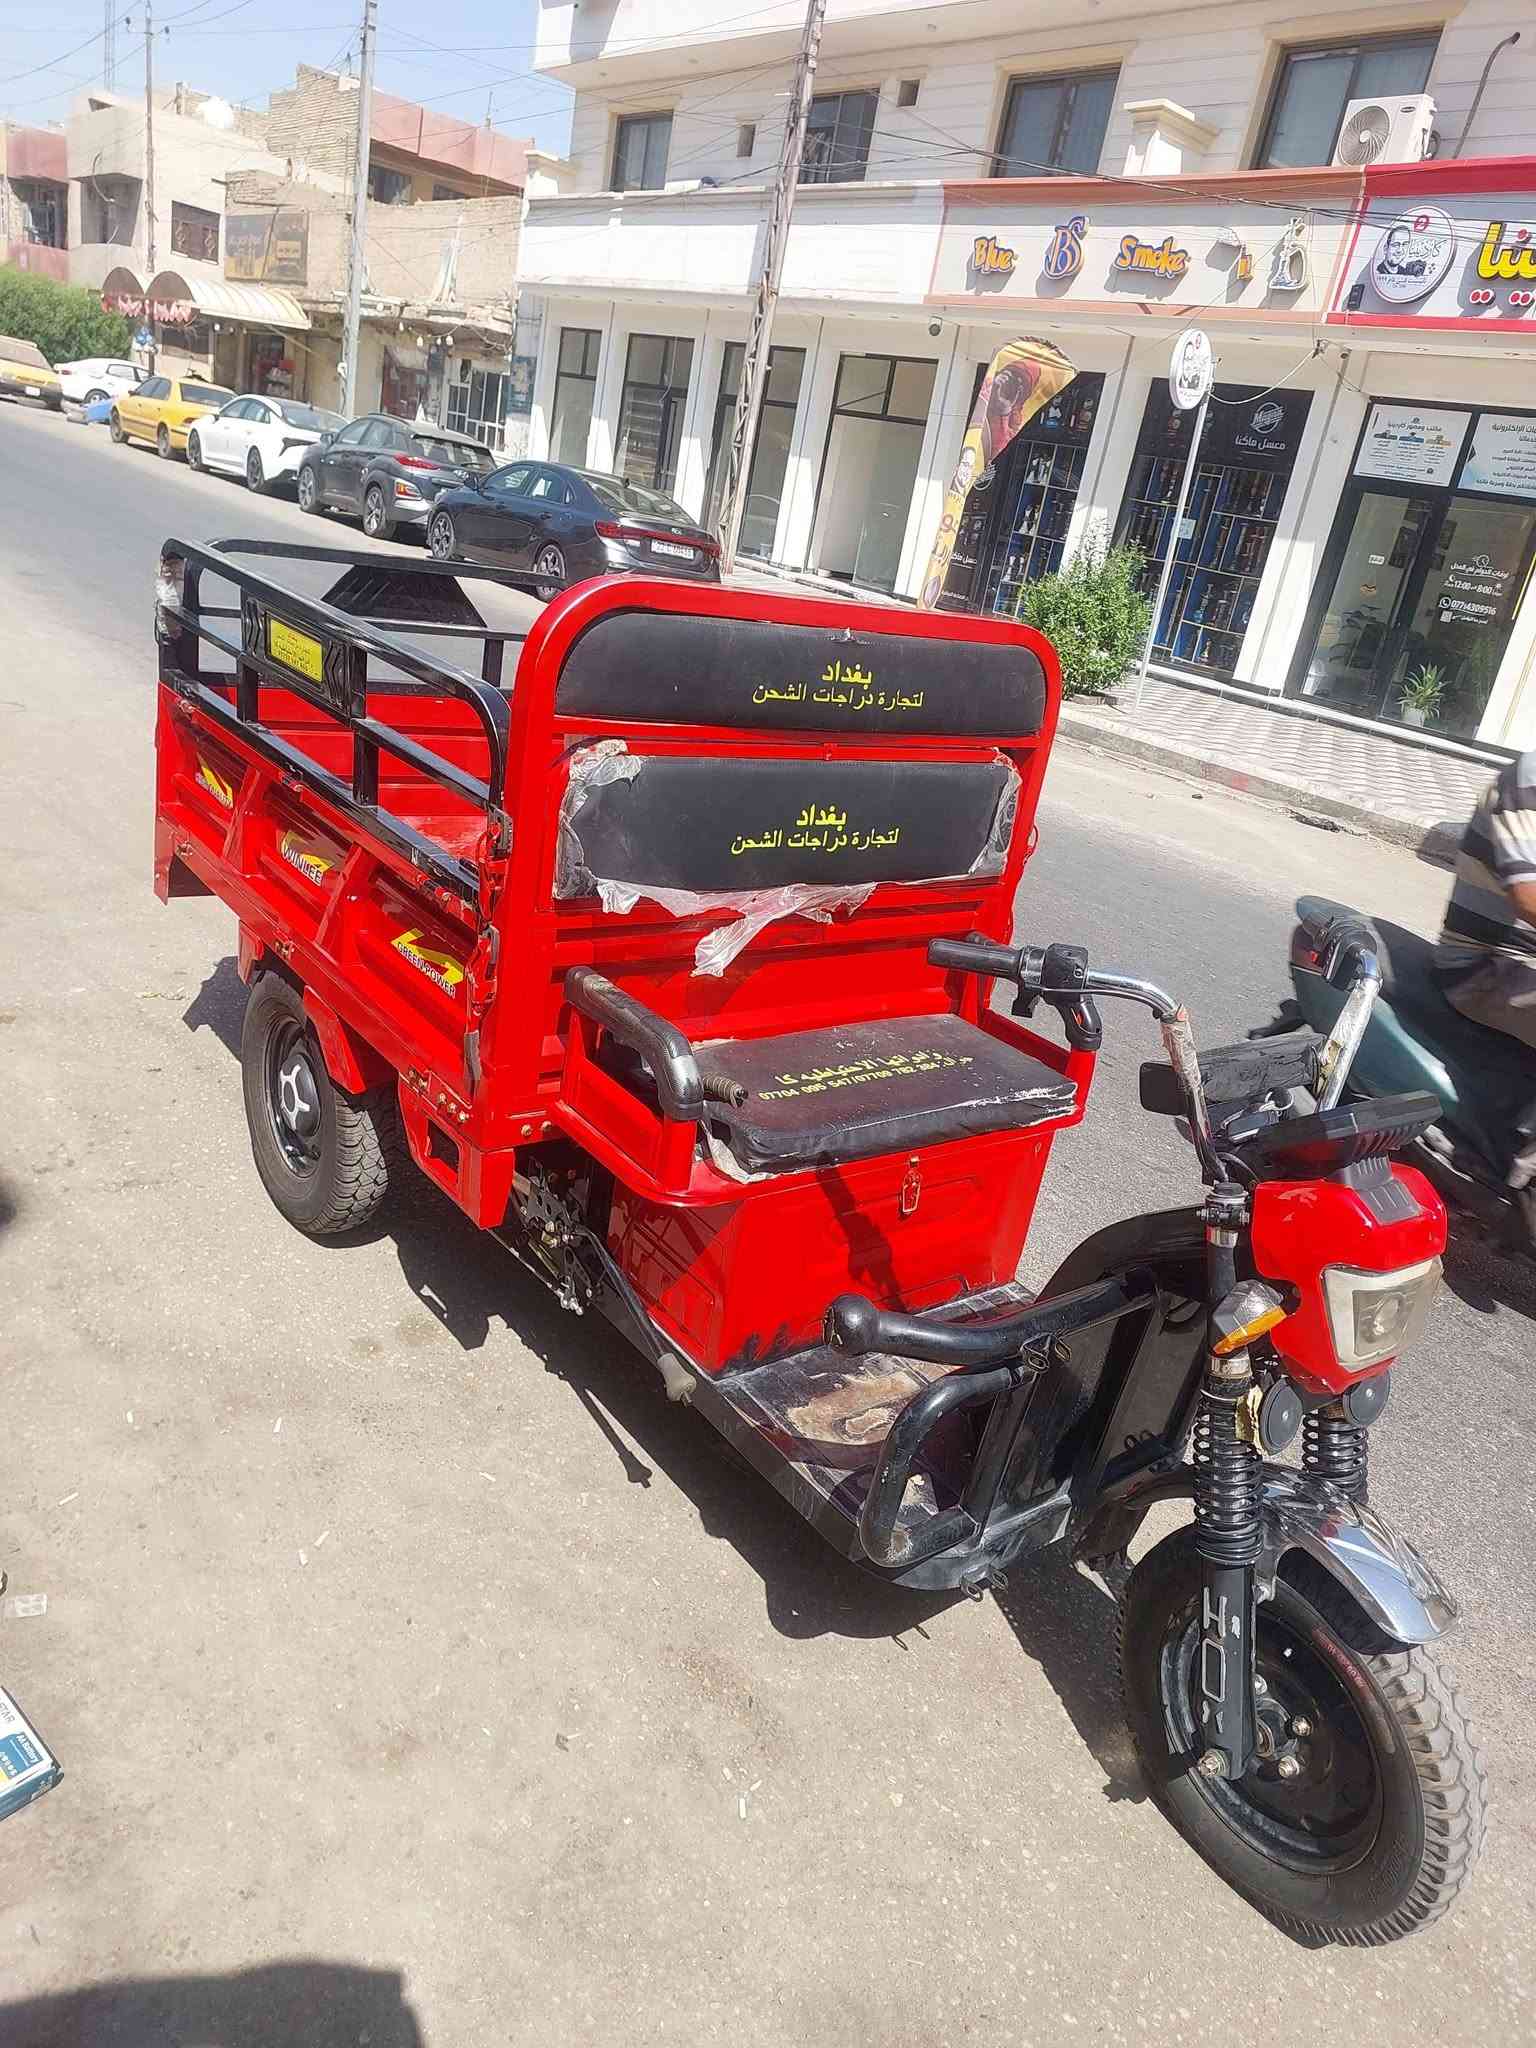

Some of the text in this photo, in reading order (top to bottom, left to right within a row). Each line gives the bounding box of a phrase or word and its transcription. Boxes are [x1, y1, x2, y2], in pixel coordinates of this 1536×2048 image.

[972, 235, 1014, 275] Blue
[1117, 234, 1188, 279] Smoke
[822, 660, 873, 690] بغداد
[752, 683, 924, 711] لتجارة دراجات الشحن
[796, 803, 847, 831] بغداد
[731, 828, 900, 855] لتجارة دراجات الشحن
[424, 962, 457, 1000] POWER
[758, 1088, 801, 1101] 07704
